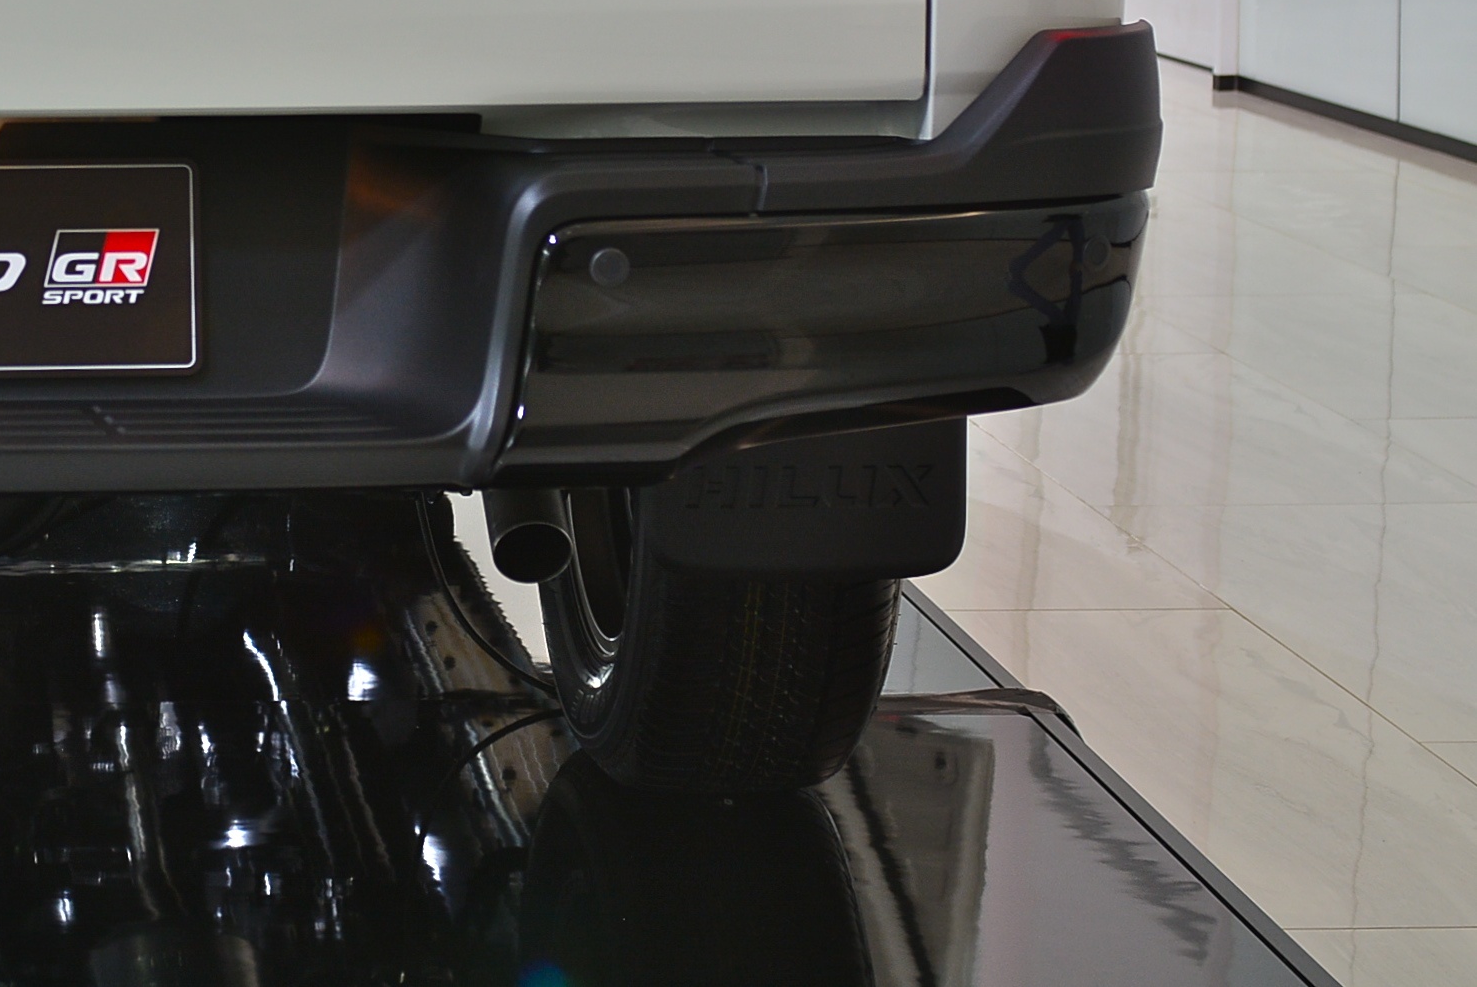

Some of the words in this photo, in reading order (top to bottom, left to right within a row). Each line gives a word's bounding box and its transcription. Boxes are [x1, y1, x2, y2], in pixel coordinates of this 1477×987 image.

[51, 252, 148, 283] GR
[42, 289, 145, 305] SPORT
[684, 464, 934, 509] HILUX
